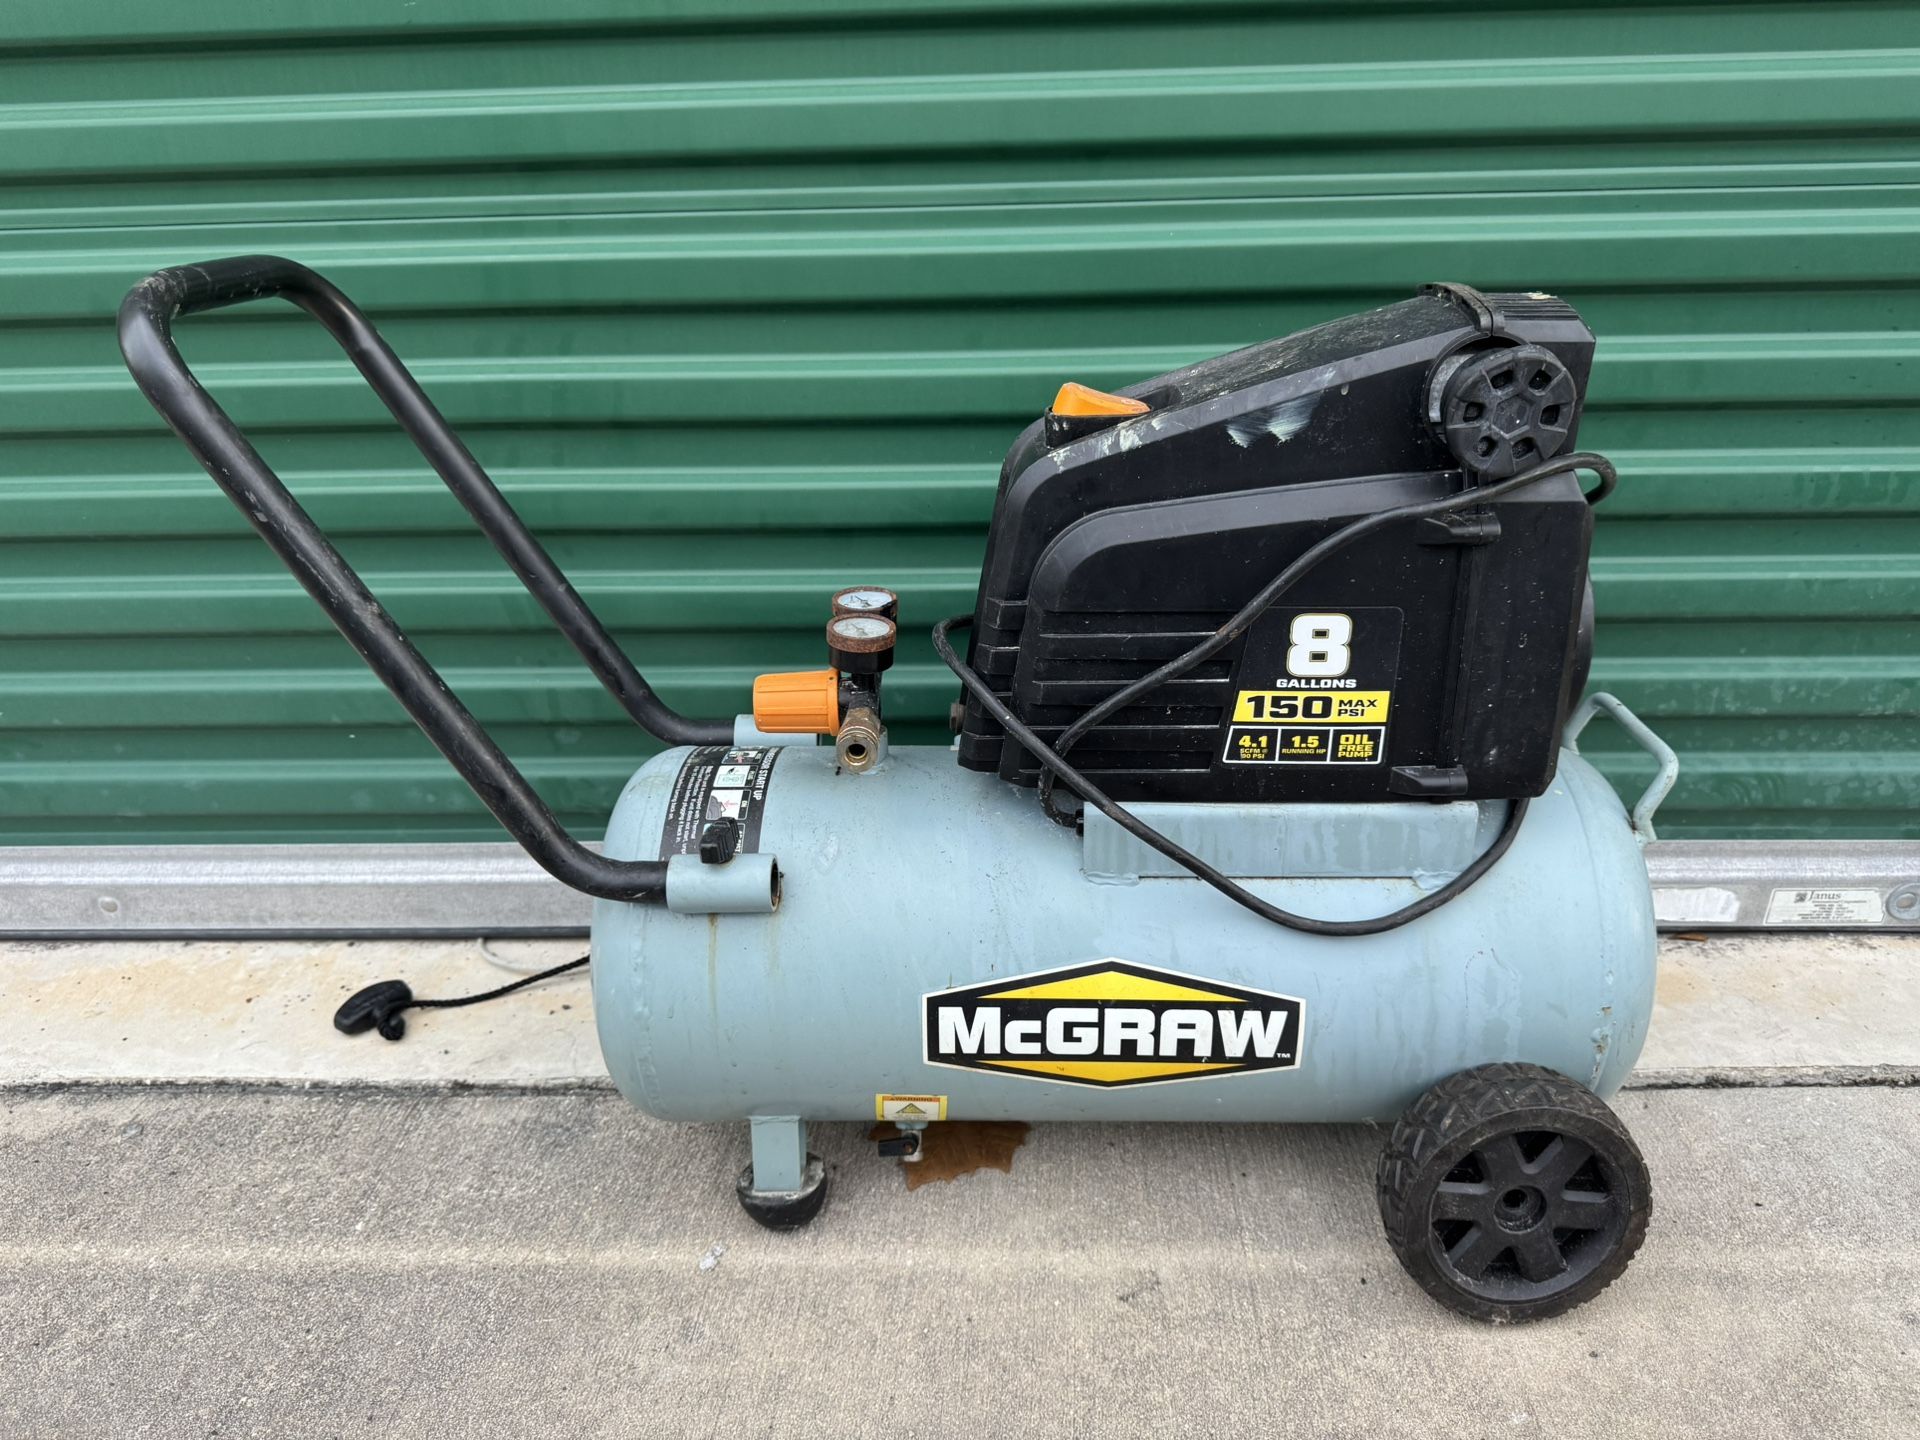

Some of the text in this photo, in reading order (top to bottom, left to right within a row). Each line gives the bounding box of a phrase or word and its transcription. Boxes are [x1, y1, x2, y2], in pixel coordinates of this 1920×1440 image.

[1286, 613, 1353, 677] 8
[1276, 678, 1357, 689] GALLONS
[1247, 695, 1333, 719] 150
[1338, 699, 1378, 708] MAX
[1337, 709, 1365, 717] PSI
[1238, 735, 1268, 748] 4.1
[1291, 735, 1319, 748] 1.5
[1339, 734, 1374, 745] OIL
[755, 769, 768, 789] START
[753, 789, 763, 800] UP
[741, 800, 748, 808] ON
[1808, 890, 1841, 901] Janus
[938, 1006, 1289, 1058] McGRAW
